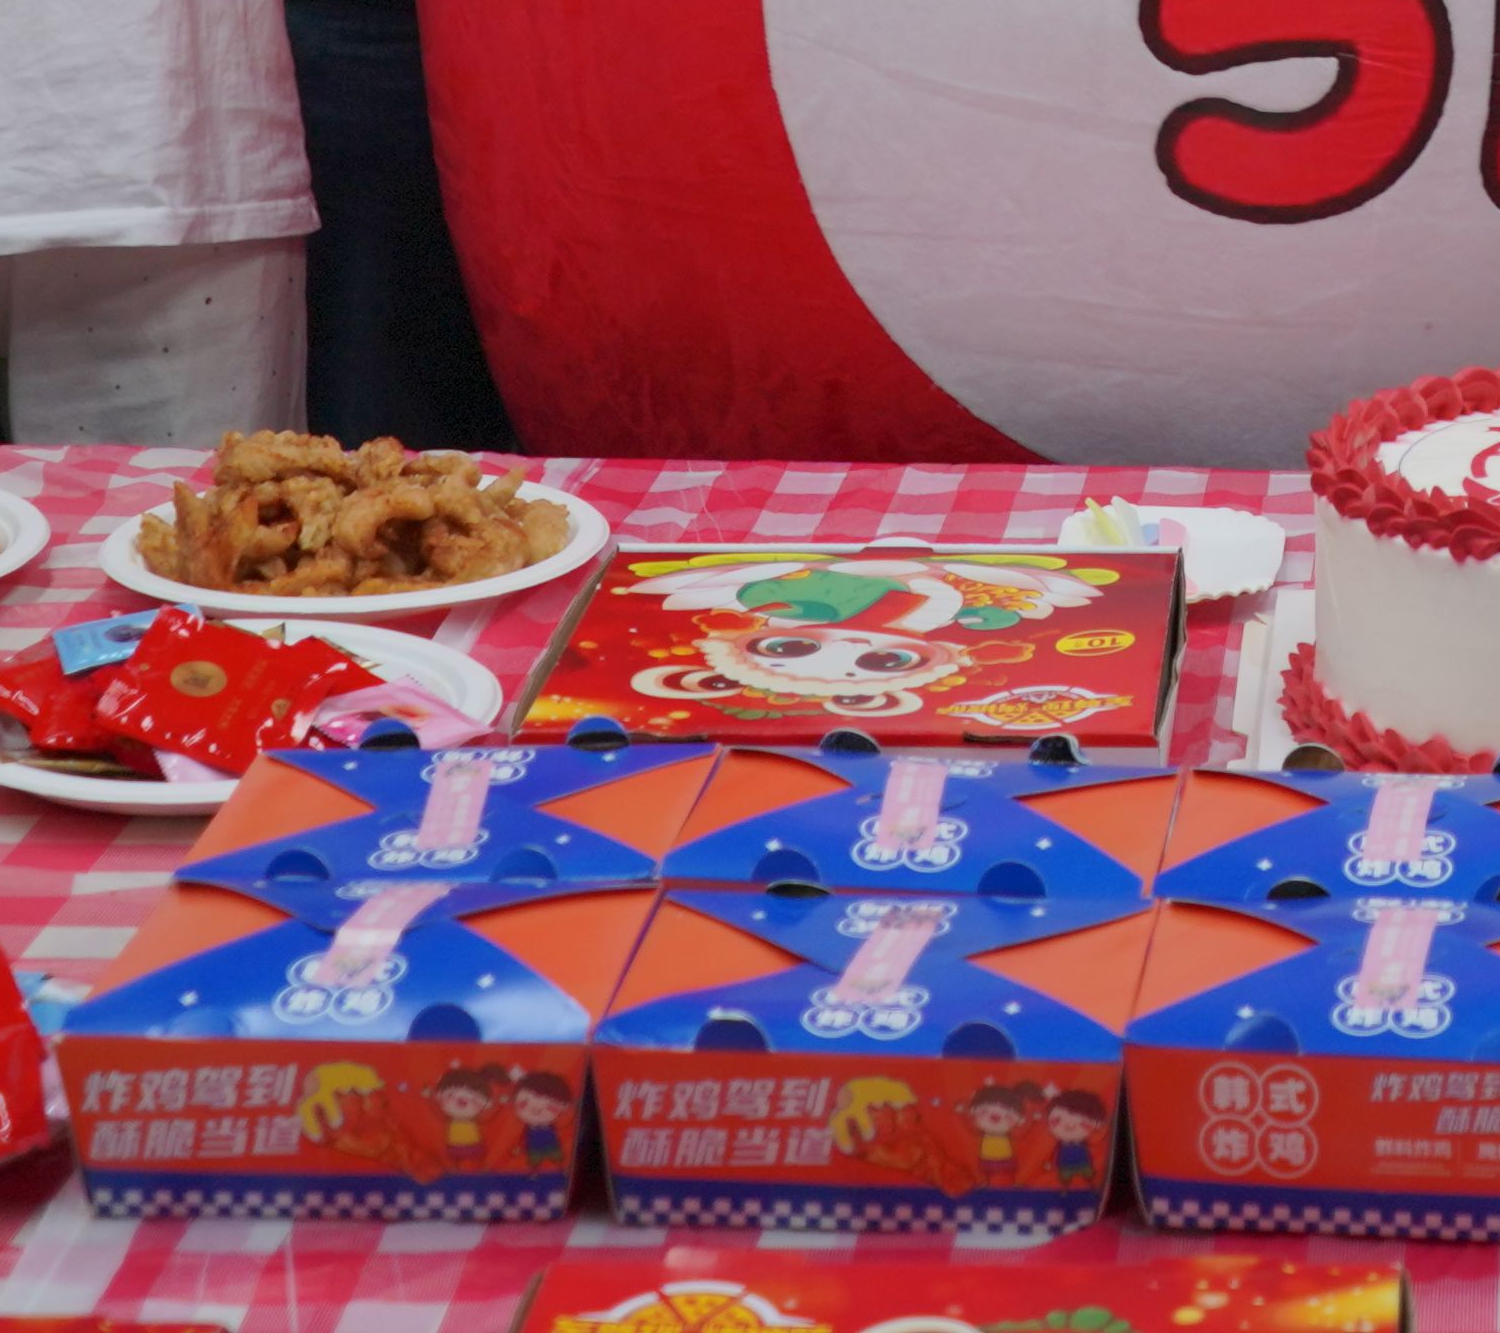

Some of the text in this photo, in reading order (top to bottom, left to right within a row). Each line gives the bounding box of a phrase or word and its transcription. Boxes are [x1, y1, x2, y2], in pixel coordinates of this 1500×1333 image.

[83, 1063, 297, 1116] 炸鸡驾到
[613, 1074, 831, 1121] 炸鸡驾到
[89, 1117, 304, 1162] 酥脆当道
[618, 1124, 837, 1169] 酥脆当道
